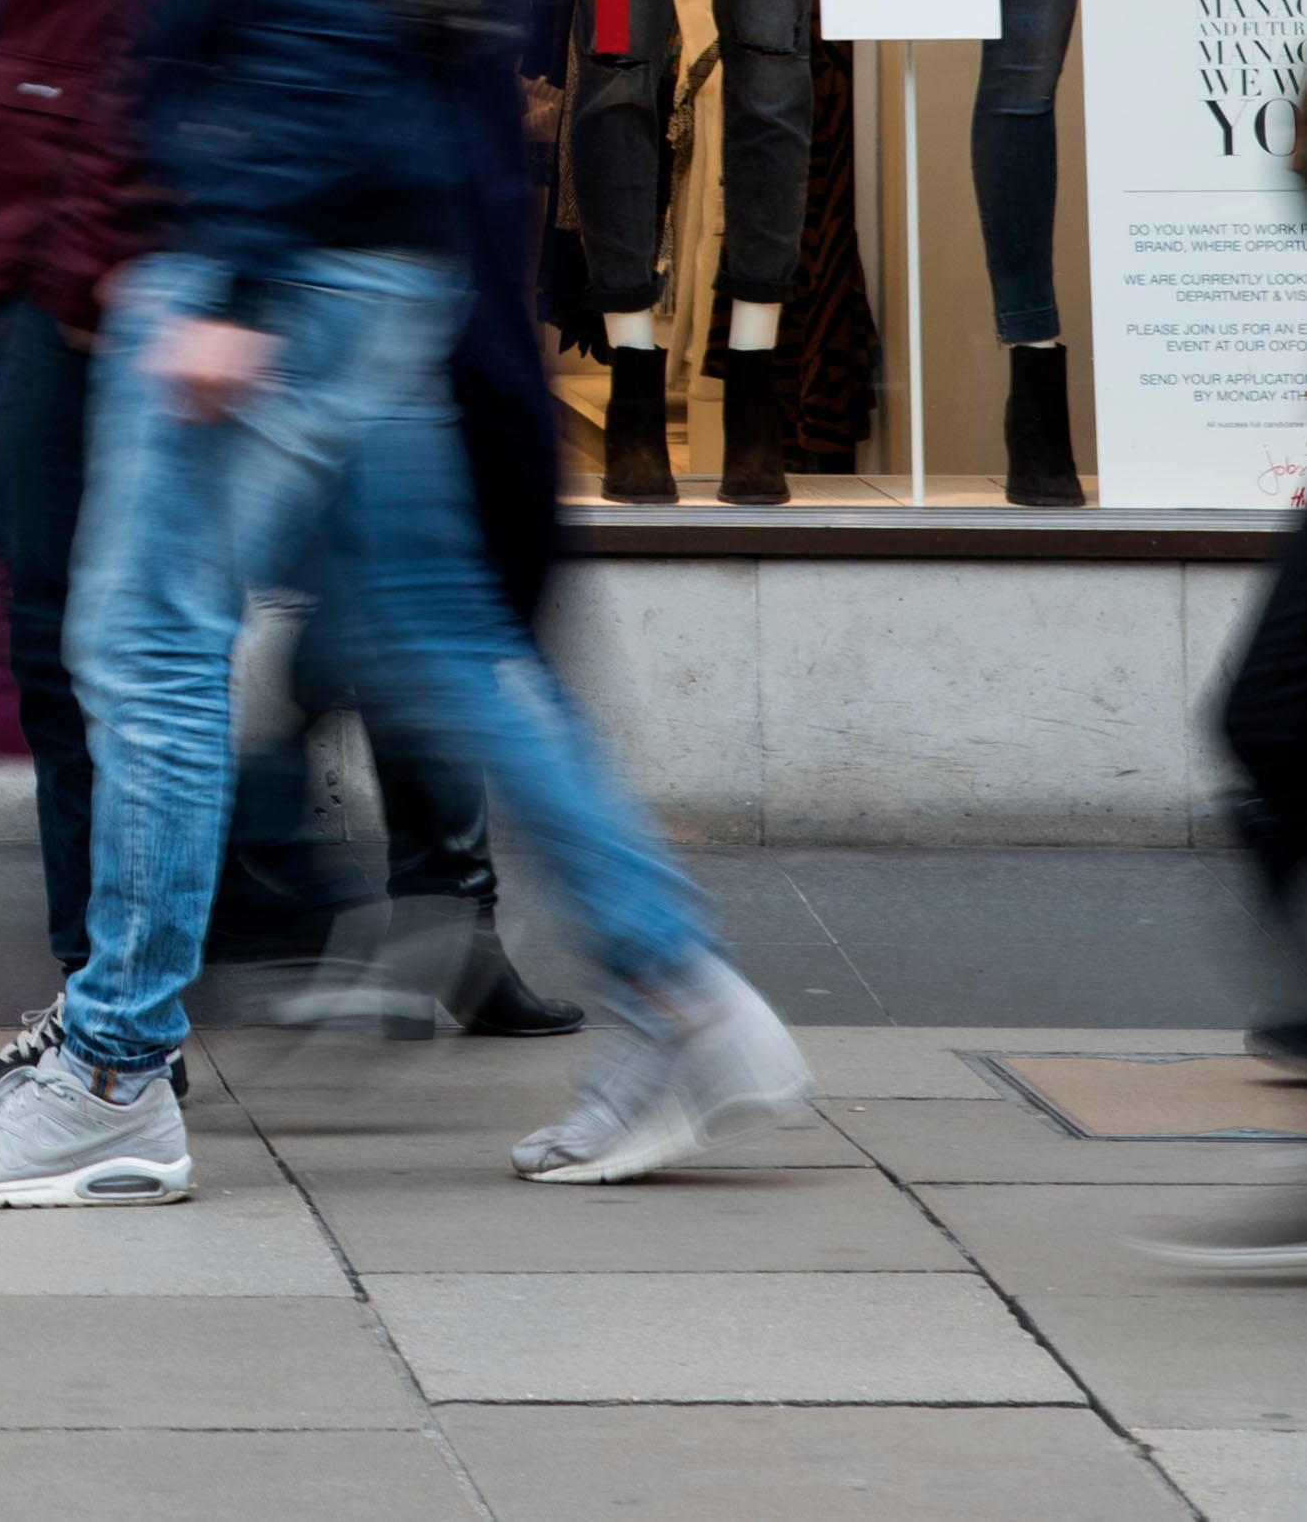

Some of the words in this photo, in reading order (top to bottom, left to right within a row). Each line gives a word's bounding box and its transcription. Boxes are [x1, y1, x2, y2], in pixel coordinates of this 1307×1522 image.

[1196, 21, 1237, 37] AND
[1197, 68, 1262, 96] WE
[1129, 224, 1150, 236] DO
[1153, 224, 1184, 236] YOU
[1187, 224, 1228, 236] WANT
[1232, 224, 1251, 236] TO
[1255, 224, 1297, 235] WORK
[1134, 241, 1187, 254] BRAND,
[1191, 240, 1241, 252] WHERE
[1123, 274, 1146, 285] WE
[1149, 274, 1178, 285] ARE
[1181, 274, 1263, 286] CURRENTLY
[1176, 290, 1269, 302] DEPARTMENT
[1272, 290, 1281, 301] &
[1126, 324, 1180, 336] PLEASE
[1183, 324, 1215, 335] JOIN
[1218, 324, 1238, 335] US
[1242, 324, 1271, 335] FOR
[1275, 324, 1294, 335] AN
[1166, 340, 1211, 352] EVENT
[1214, 340, 1232, 352] AT
[1235, 340, 1265, 352] OUR
[1139, 374, 1178, 386] SEND
[1182, 374, 1221, 386] YOUR
[1193, 390, 1214, 402] BY
[1216, 390, 1278, 402] MONDAY
